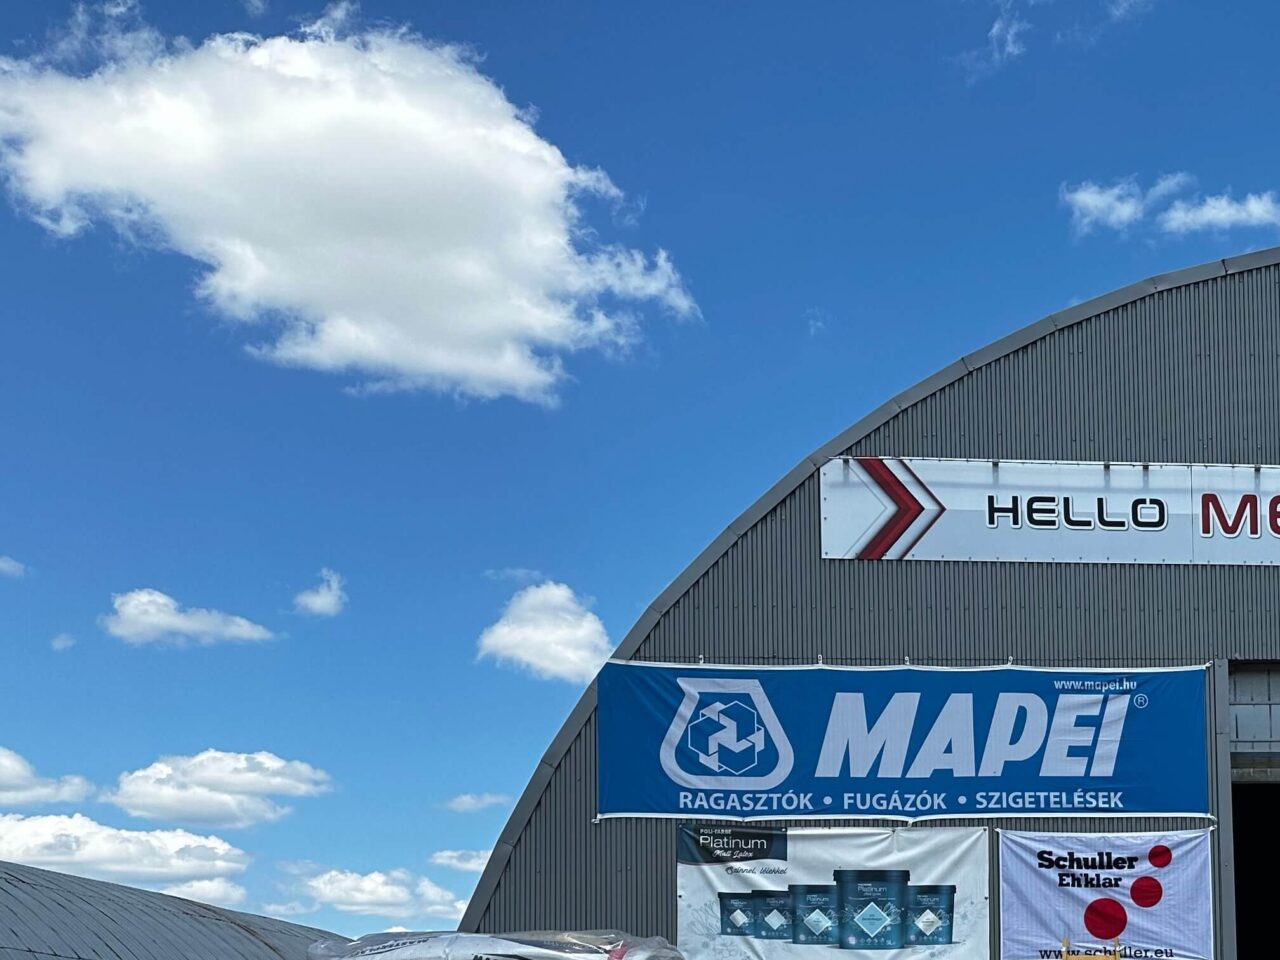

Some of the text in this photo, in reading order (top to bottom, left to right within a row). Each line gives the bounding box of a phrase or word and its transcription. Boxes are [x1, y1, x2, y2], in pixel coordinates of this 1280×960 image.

[988, 494, 1166, 528] HELLO
[1054, 679, 1137, 692] www.mapei.hu
[815, 692, 1132, 778] MAPEI
[679, 788, 1123, 811] RAGASZTÓK FUGÁZÓK SZIGETELÉSEK
[700, 835, 767, 849] Platinum
[1037, 850, 1139, 870] Schuller
